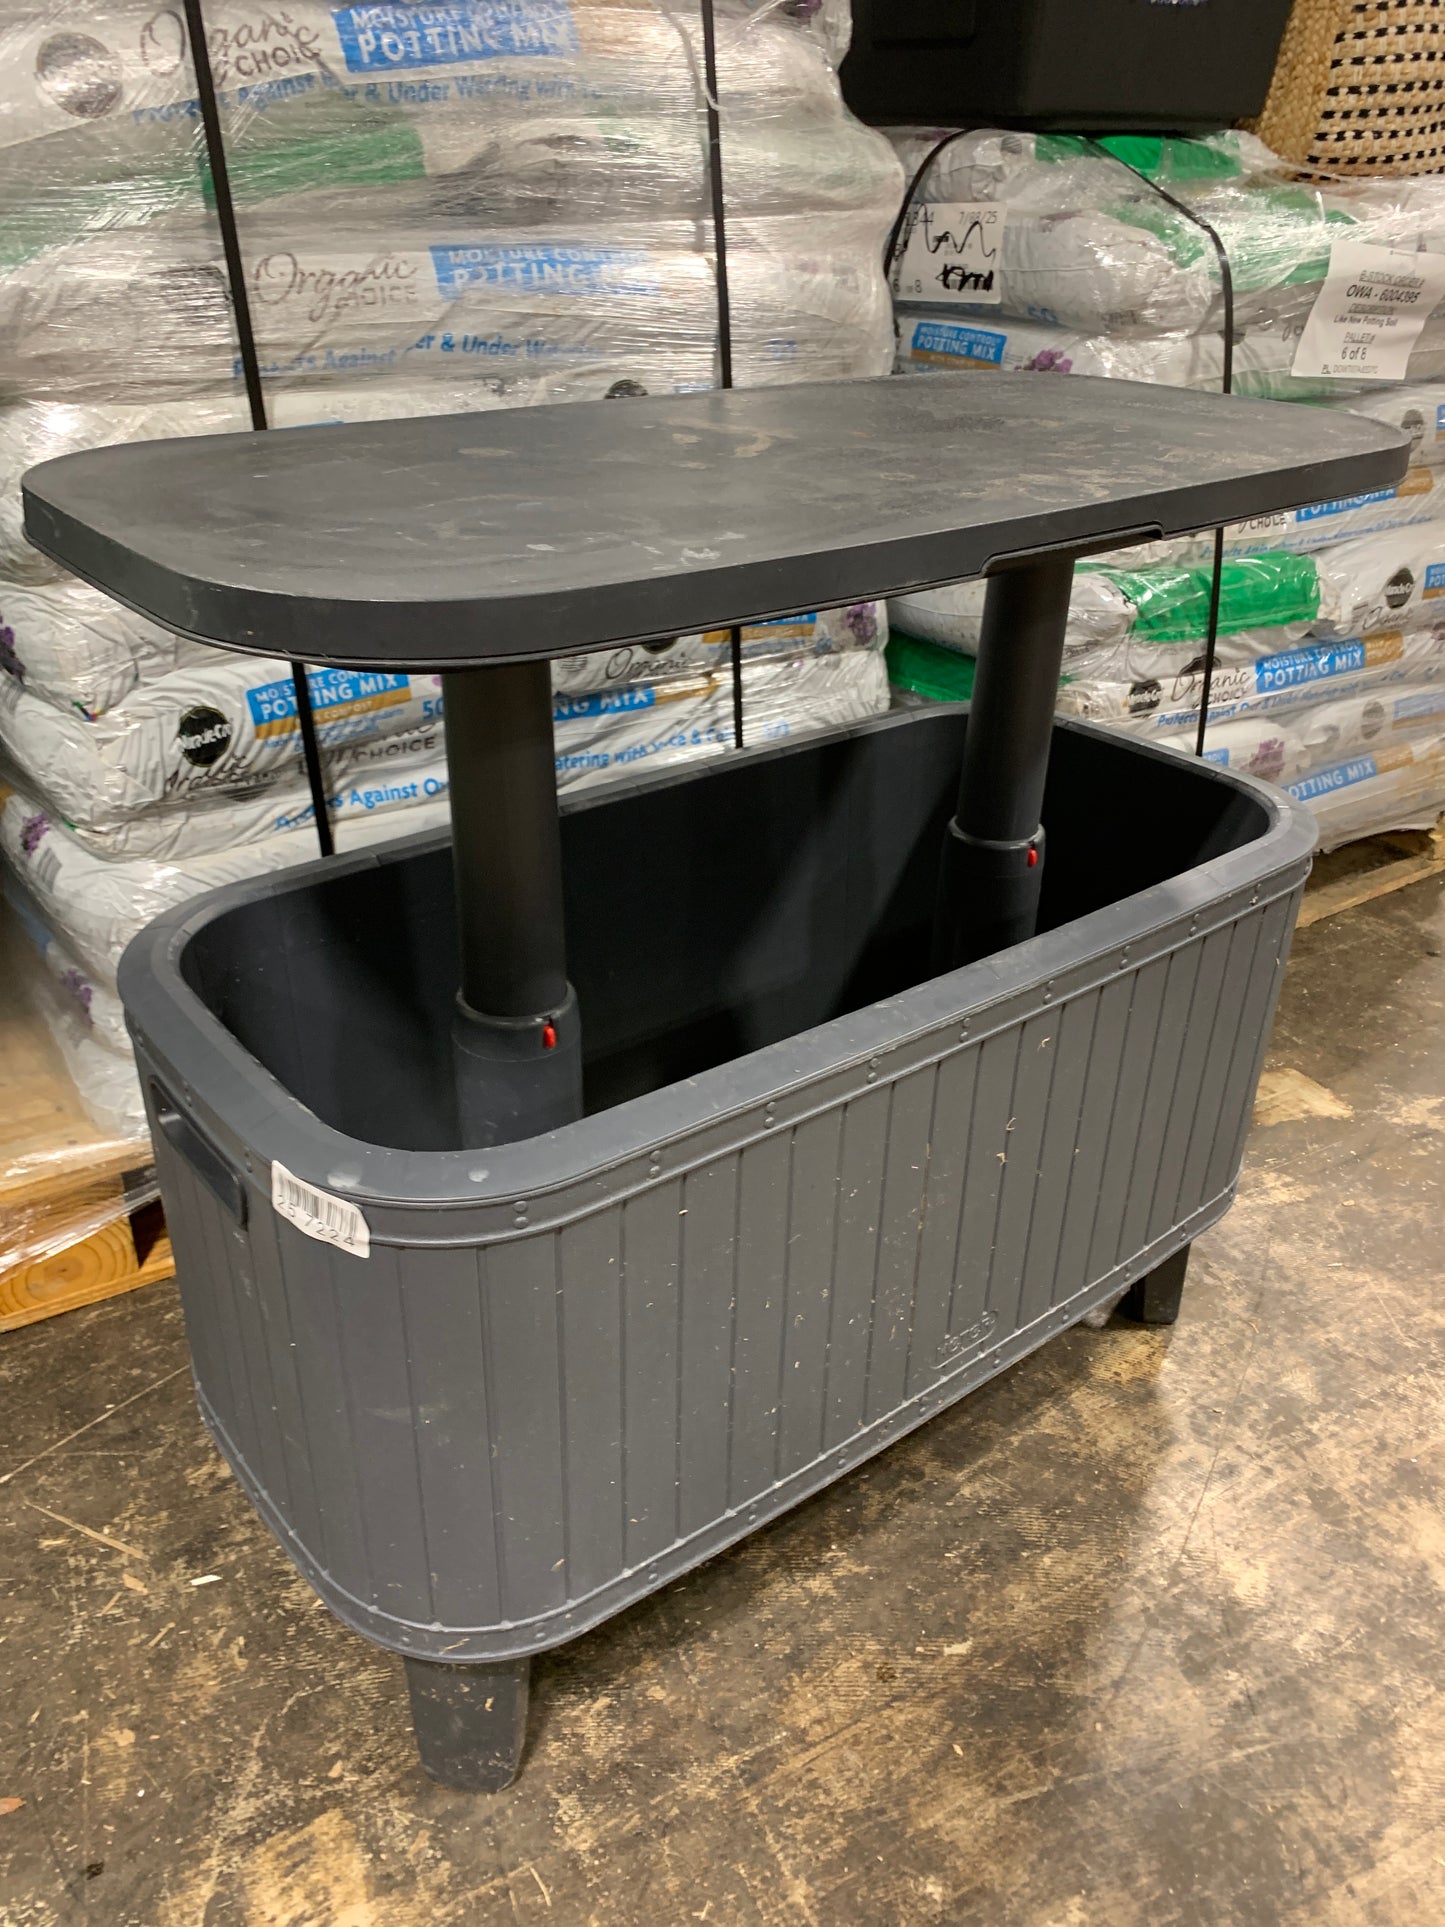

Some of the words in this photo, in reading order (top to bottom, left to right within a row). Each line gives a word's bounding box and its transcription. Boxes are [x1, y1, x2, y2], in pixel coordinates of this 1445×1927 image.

[357, 22, 500, 64] POTTING
[253, 250, 418, 323] Organic
[1346, 285, 1374, 298] OWA
[462, 333, 520, 356] Under
[916, 335, 969, 355] POTTING
[971, 344, 996, 361] MIX
[1350, 347, 1360, 360] of
[1263, 660, 1330, 689] POTTING
[1335, 650, 1362, 672] MIX
[359, 674, 398, 695] MIX
[554, 749, 610, 770] atering
[1288, 771, 1345, 799] OTTING
[1347, 759, 1374, 780] MIX
[350, 784, 418, 810] Against
